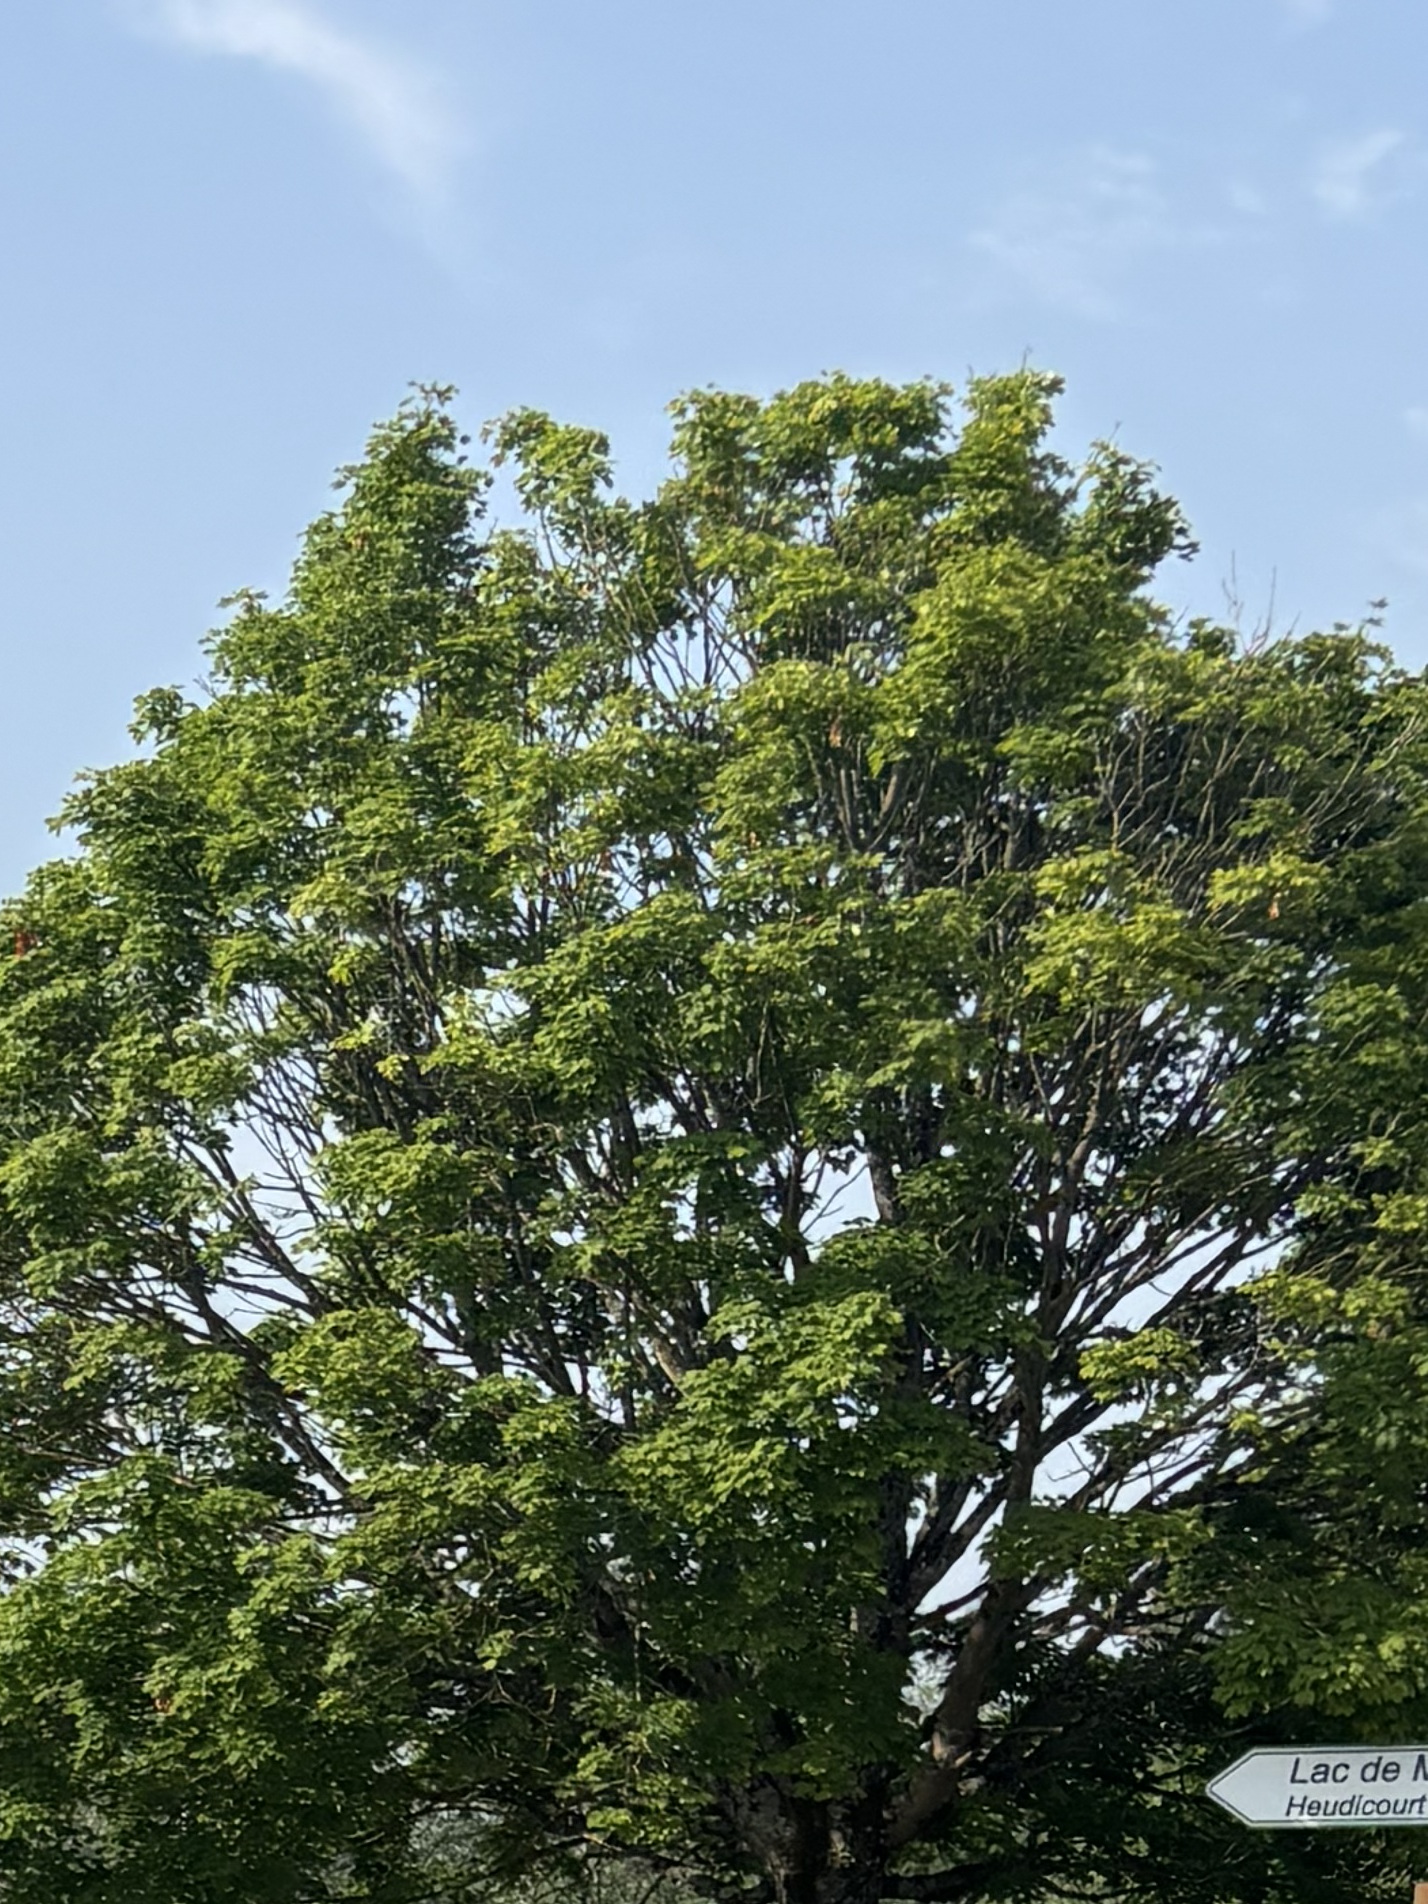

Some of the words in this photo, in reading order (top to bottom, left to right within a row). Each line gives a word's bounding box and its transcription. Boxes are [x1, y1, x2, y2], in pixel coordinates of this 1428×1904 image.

[1289, 1757, 1350, 1784] Lac
[1360, 1756, 1401, 1783] de
[1285, 1794, 1426, 1817] Heudicourt
